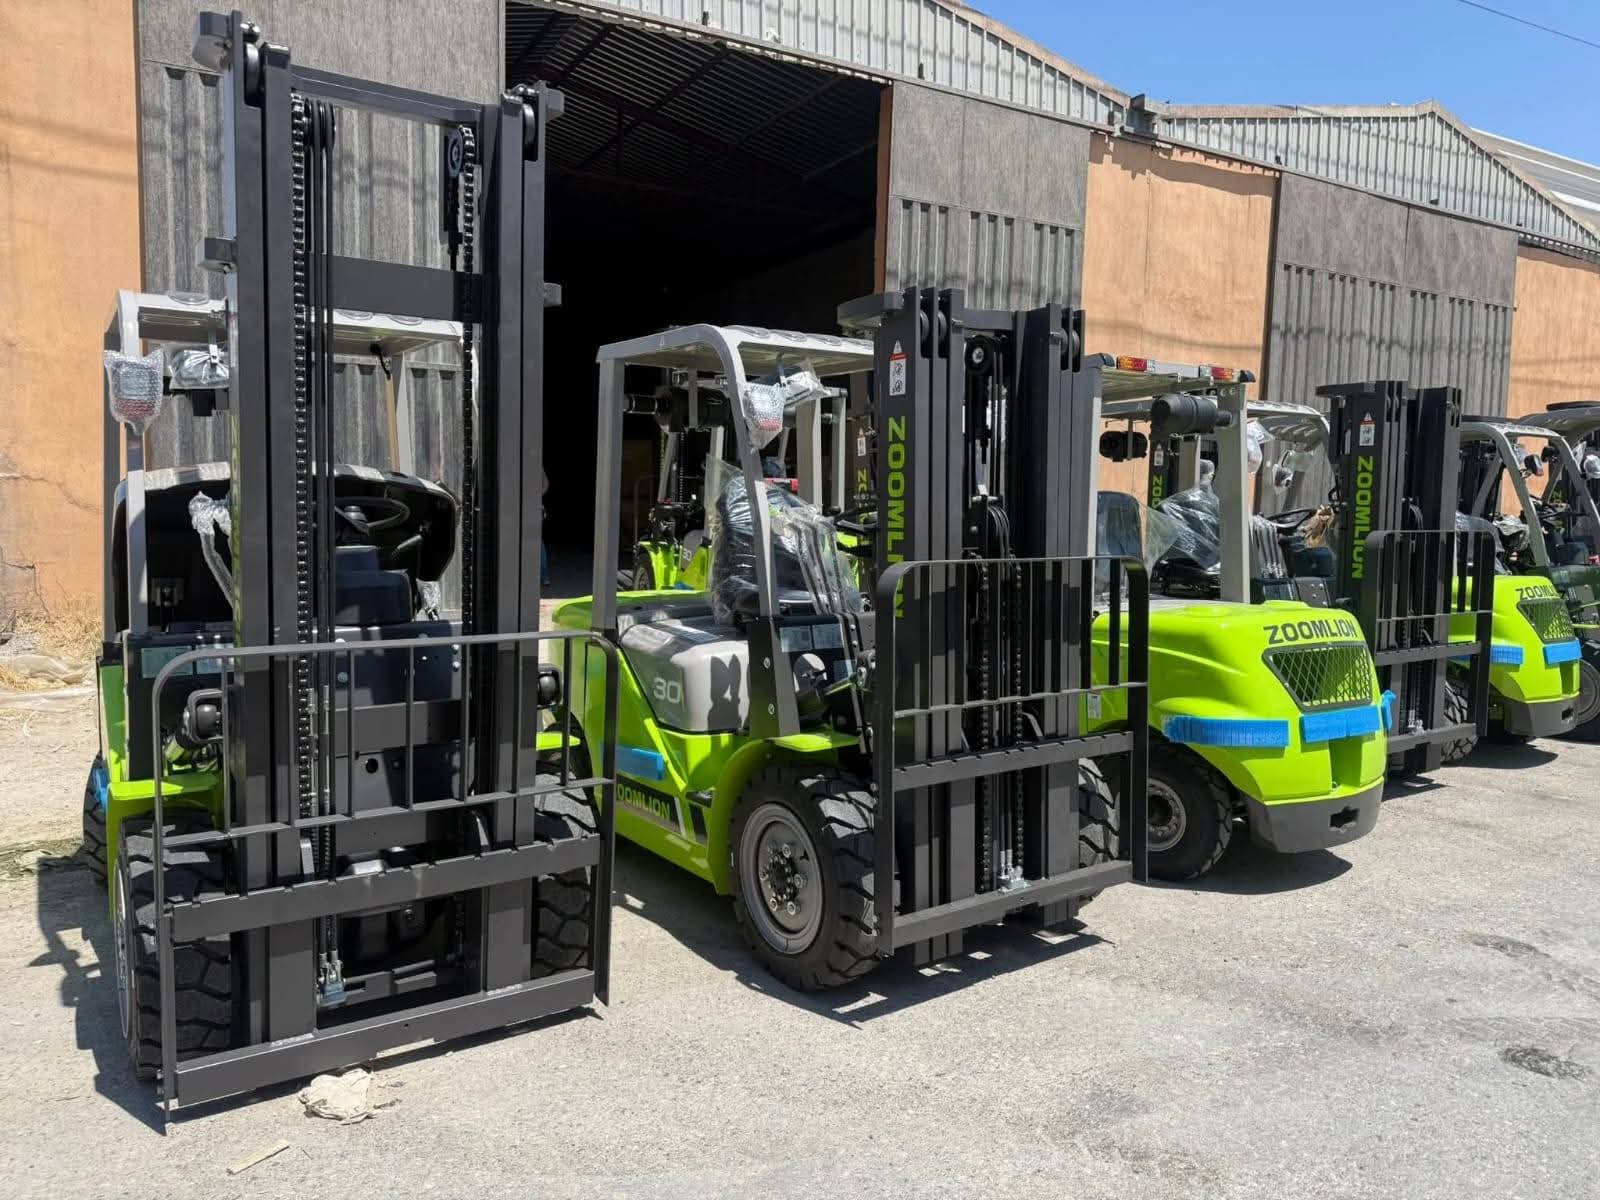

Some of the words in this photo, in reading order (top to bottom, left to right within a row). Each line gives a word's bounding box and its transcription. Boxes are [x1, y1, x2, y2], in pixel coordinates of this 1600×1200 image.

[1263, 618, 1358, 645] ZOOMLION
[653, 677, 682, 704] 30
[617, 783, 671, 821] OOMLION
